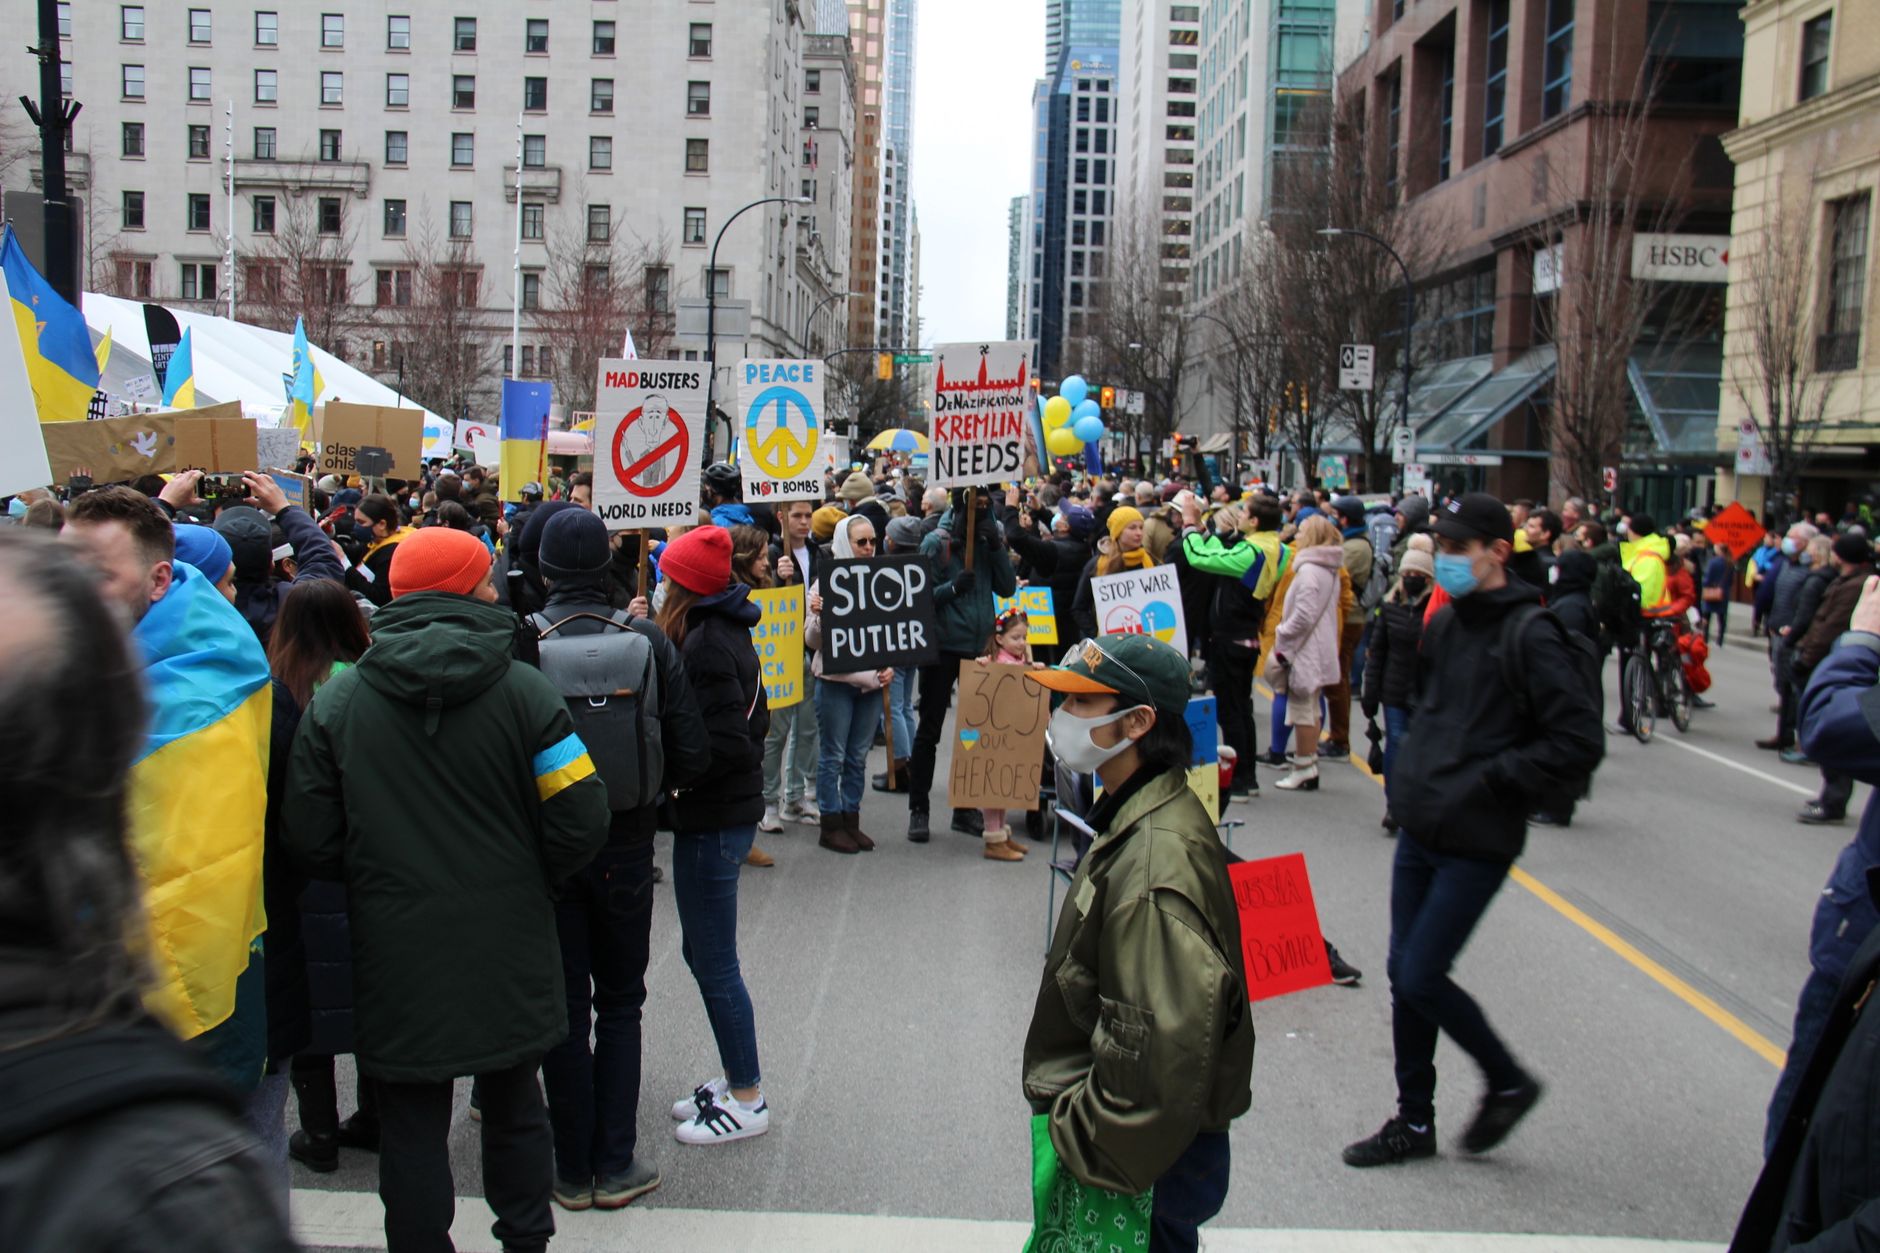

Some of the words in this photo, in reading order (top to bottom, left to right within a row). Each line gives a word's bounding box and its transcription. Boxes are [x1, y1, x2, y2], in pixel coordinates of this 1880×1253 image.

[1651, 246, 1716, 267] HSBC
[605, 371, 700, 390] MADBUSTERS
[746, 364, 813, 384] PEACE
[934, 411, 1023, 443] KREMLIN
[325, 442, 357, 457] clas
[935, 441, 1020, 481] NEEDS
[750, 481, 778, 496] NOT
[782, 479, 819, 494] BOMBS
[598, 503, 647, 520] WORLD
[651, 501, 692, 517] NEEDS
[829, 563, 926, 617] STOP
[1099, 580, 1135, 602] STOP
[1139, 574, 1172, 595] WAR
[831, 619, 928, 658] PUTLER
[953, 757, 1040, 802] HEROES
